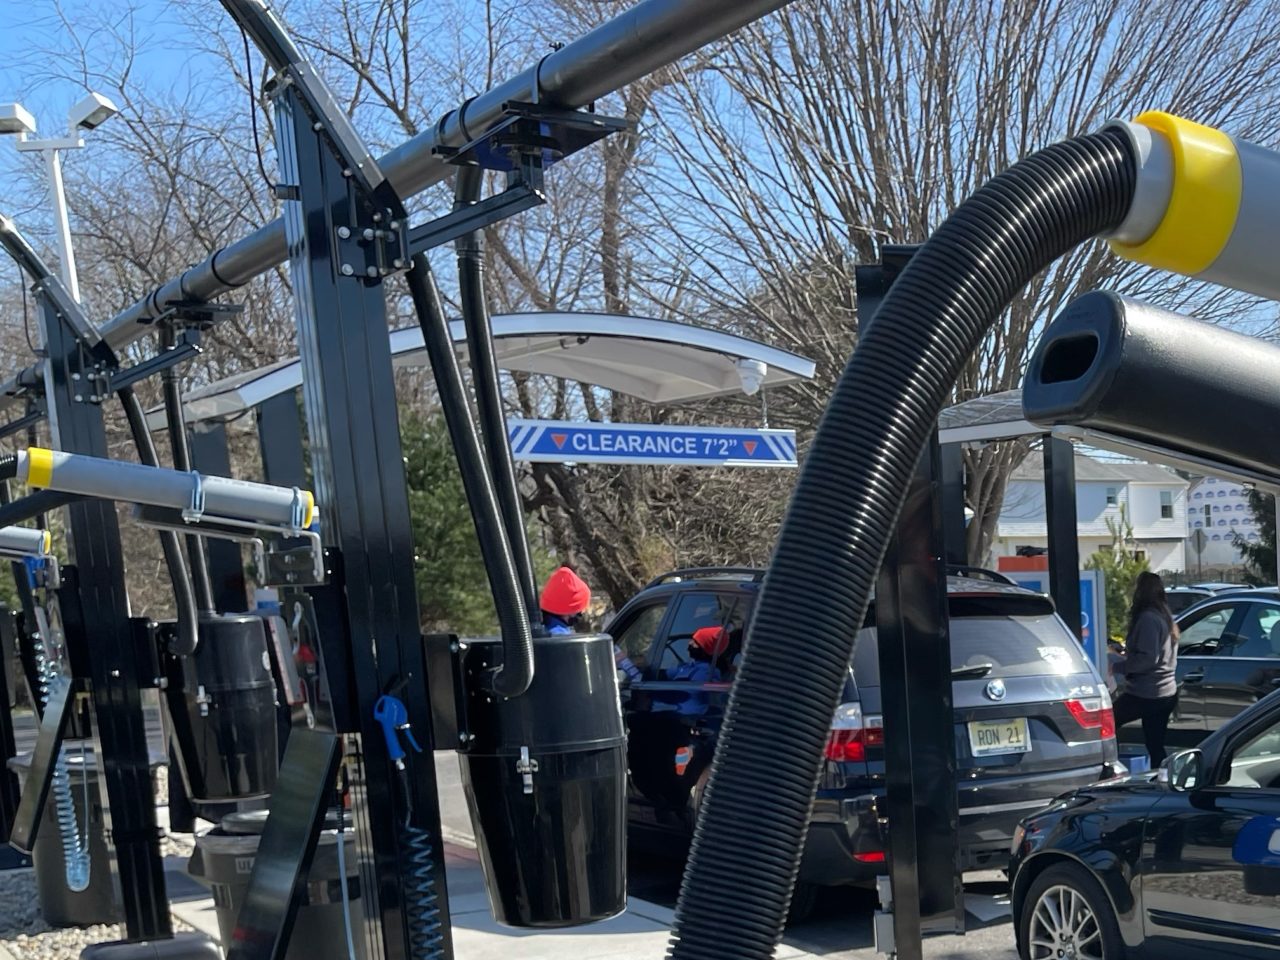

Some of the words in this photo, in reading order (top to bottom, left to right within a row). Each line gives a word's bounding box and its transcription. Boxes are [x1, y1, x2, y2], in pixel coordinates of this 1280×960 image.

[572, 433, 697, 454] CLEARANCE
[977, 728, 1000, 746] RON
[1007, 727, 1021, 744] 21
